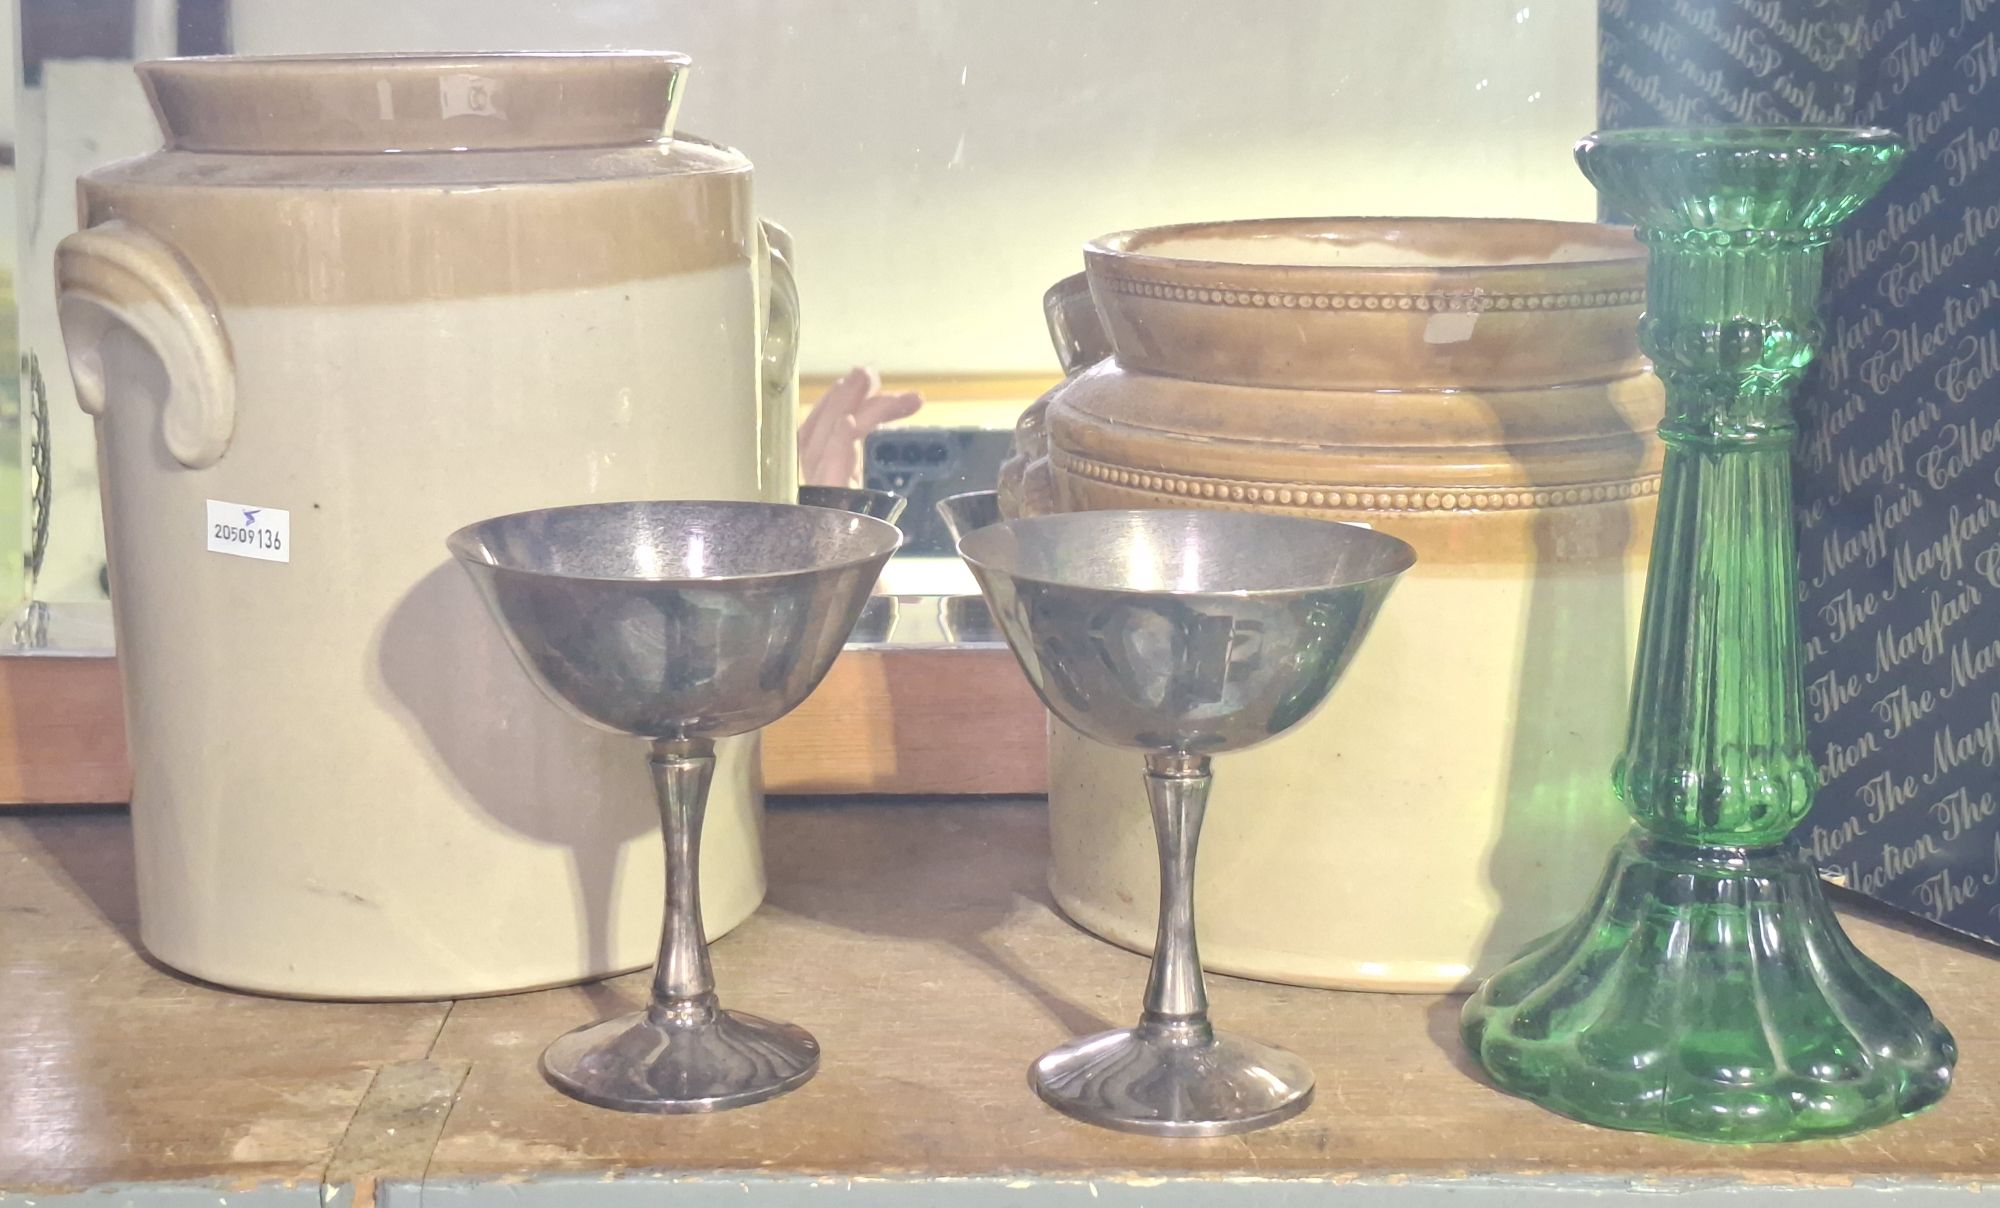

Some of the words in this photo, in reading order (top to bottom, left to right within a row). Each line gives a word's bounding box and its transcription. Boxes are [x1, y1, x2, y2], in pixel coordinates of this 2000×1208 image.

[1881, 32, 1945, 94] The
[1953, 31, 2000, 95] Th
[1878, 204, 2000, 308] Collectio
[1860, 278, 2000, 395] Collection
[1812, 483, 1922, 588] Mayfair
[1916, 417, 2000, 490] Colle
[1828, 397, 1941, 506] Mayfair
[214, 523, 282, 551] 20509136
[1817, 588, 1878, 643] The
[1882, 493, 2000, 601] Mayfair
[1806, 669, 1863, 723] The
[1865, 579, 1982, 684] Mayfair
[1856, 770, 1919, 824] The
[1922, 691, 2000, 785] Mayf
[1871, 685, 1936, 739] The
[1928, 786, 1996, 841] The
[1911, 868, 1979, 921] The
